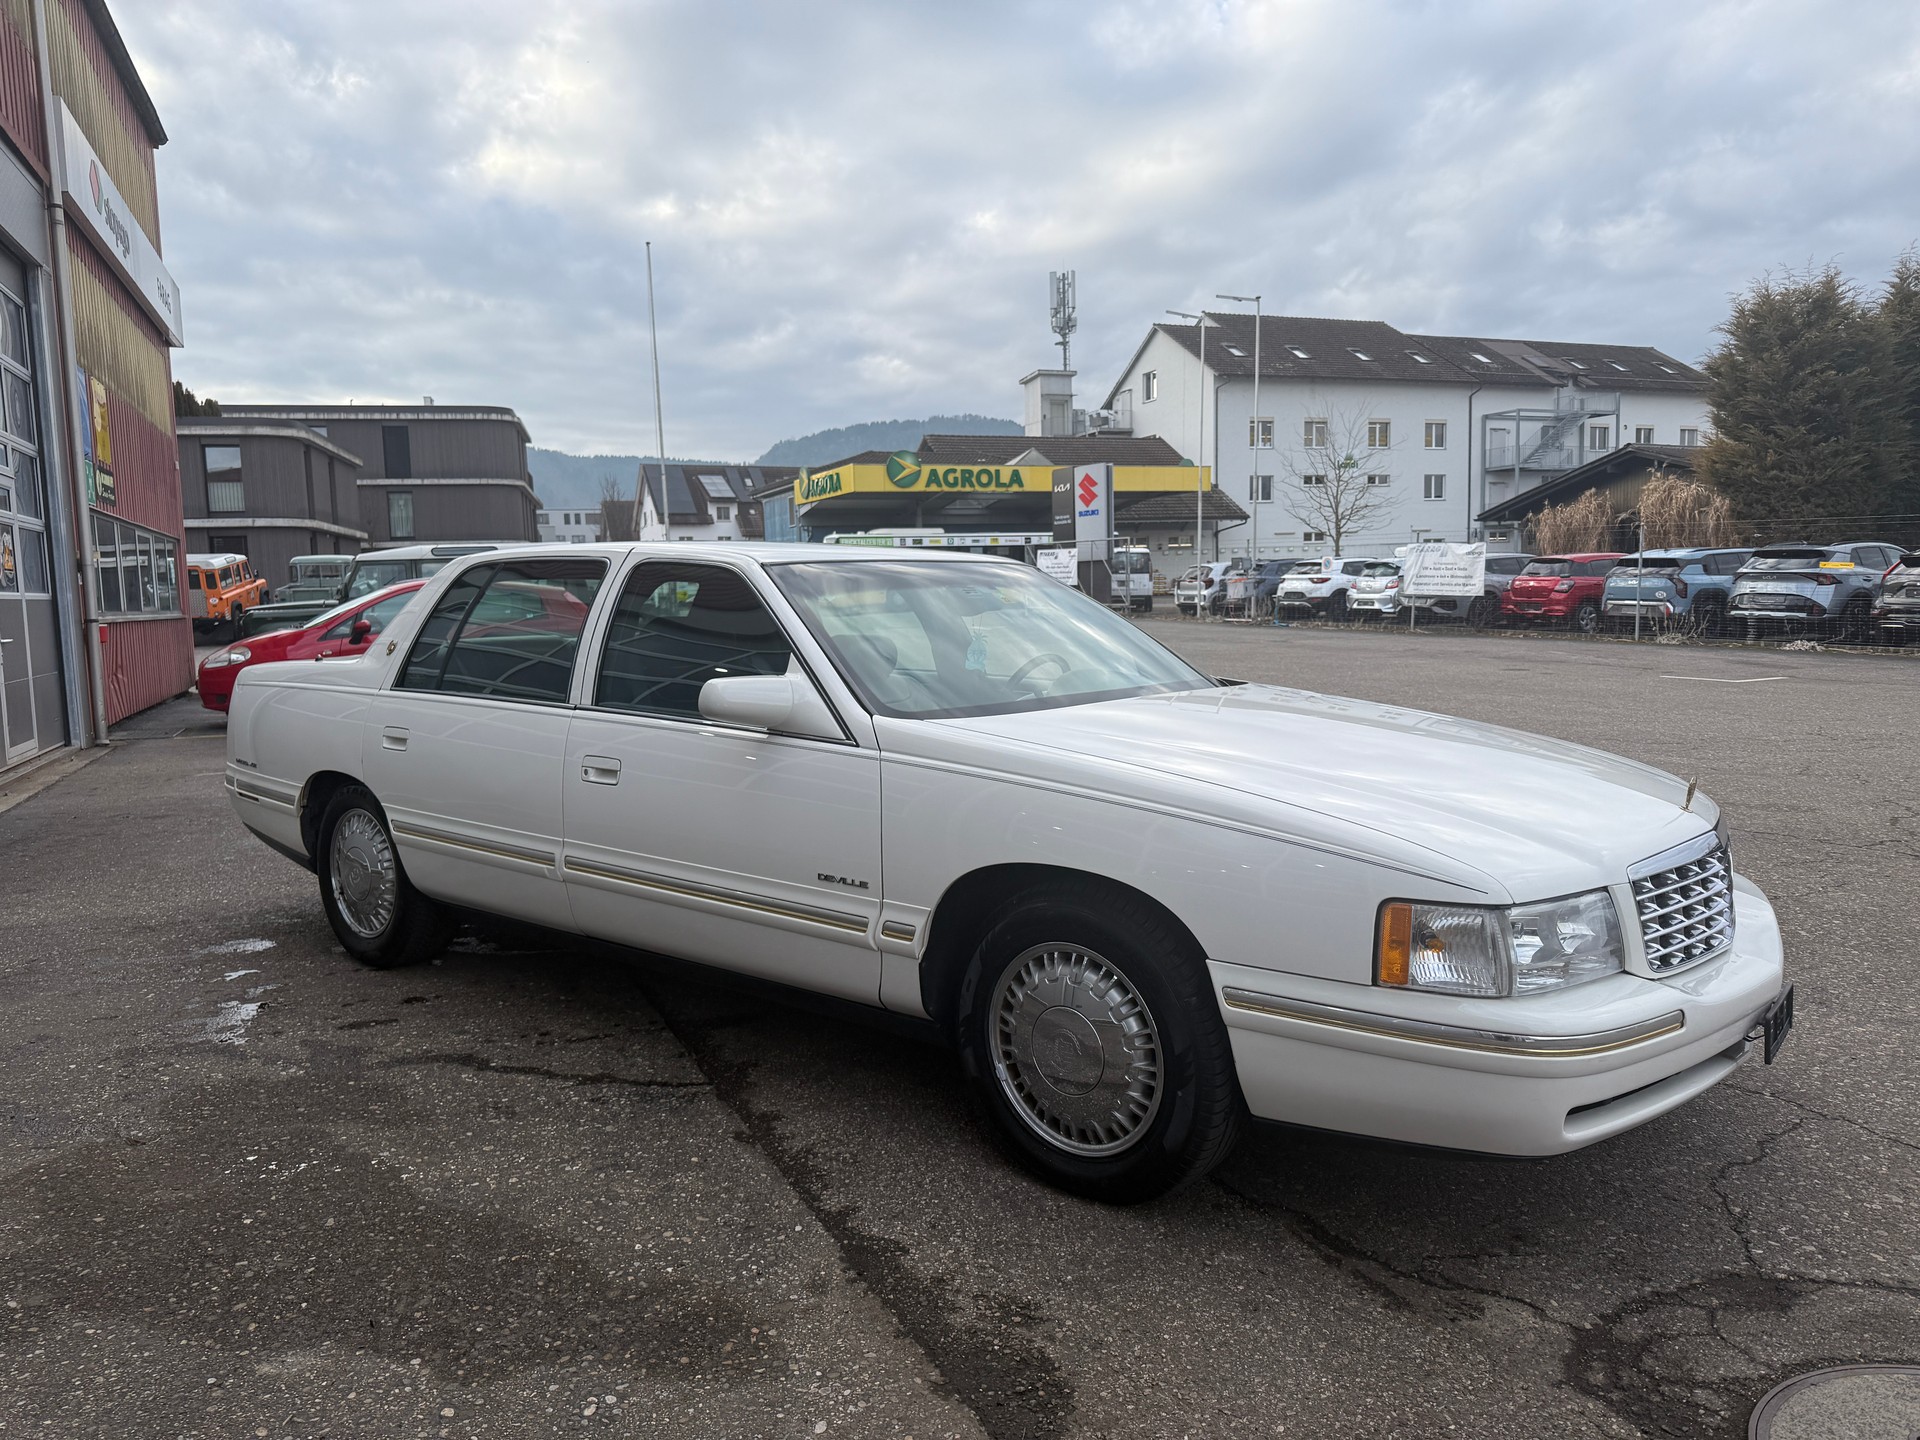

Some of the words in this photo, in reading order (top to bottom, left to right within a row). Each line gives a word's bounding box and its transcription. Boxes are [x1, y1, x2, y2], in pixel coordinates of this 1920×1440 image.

[925, 468, 1024, 488] AGROLA
[1054, 483, 1070, 492] KIA
[1078, 509, 1099, 517] SUZUKI
[817, 873, 869, 889] DEVILLE
